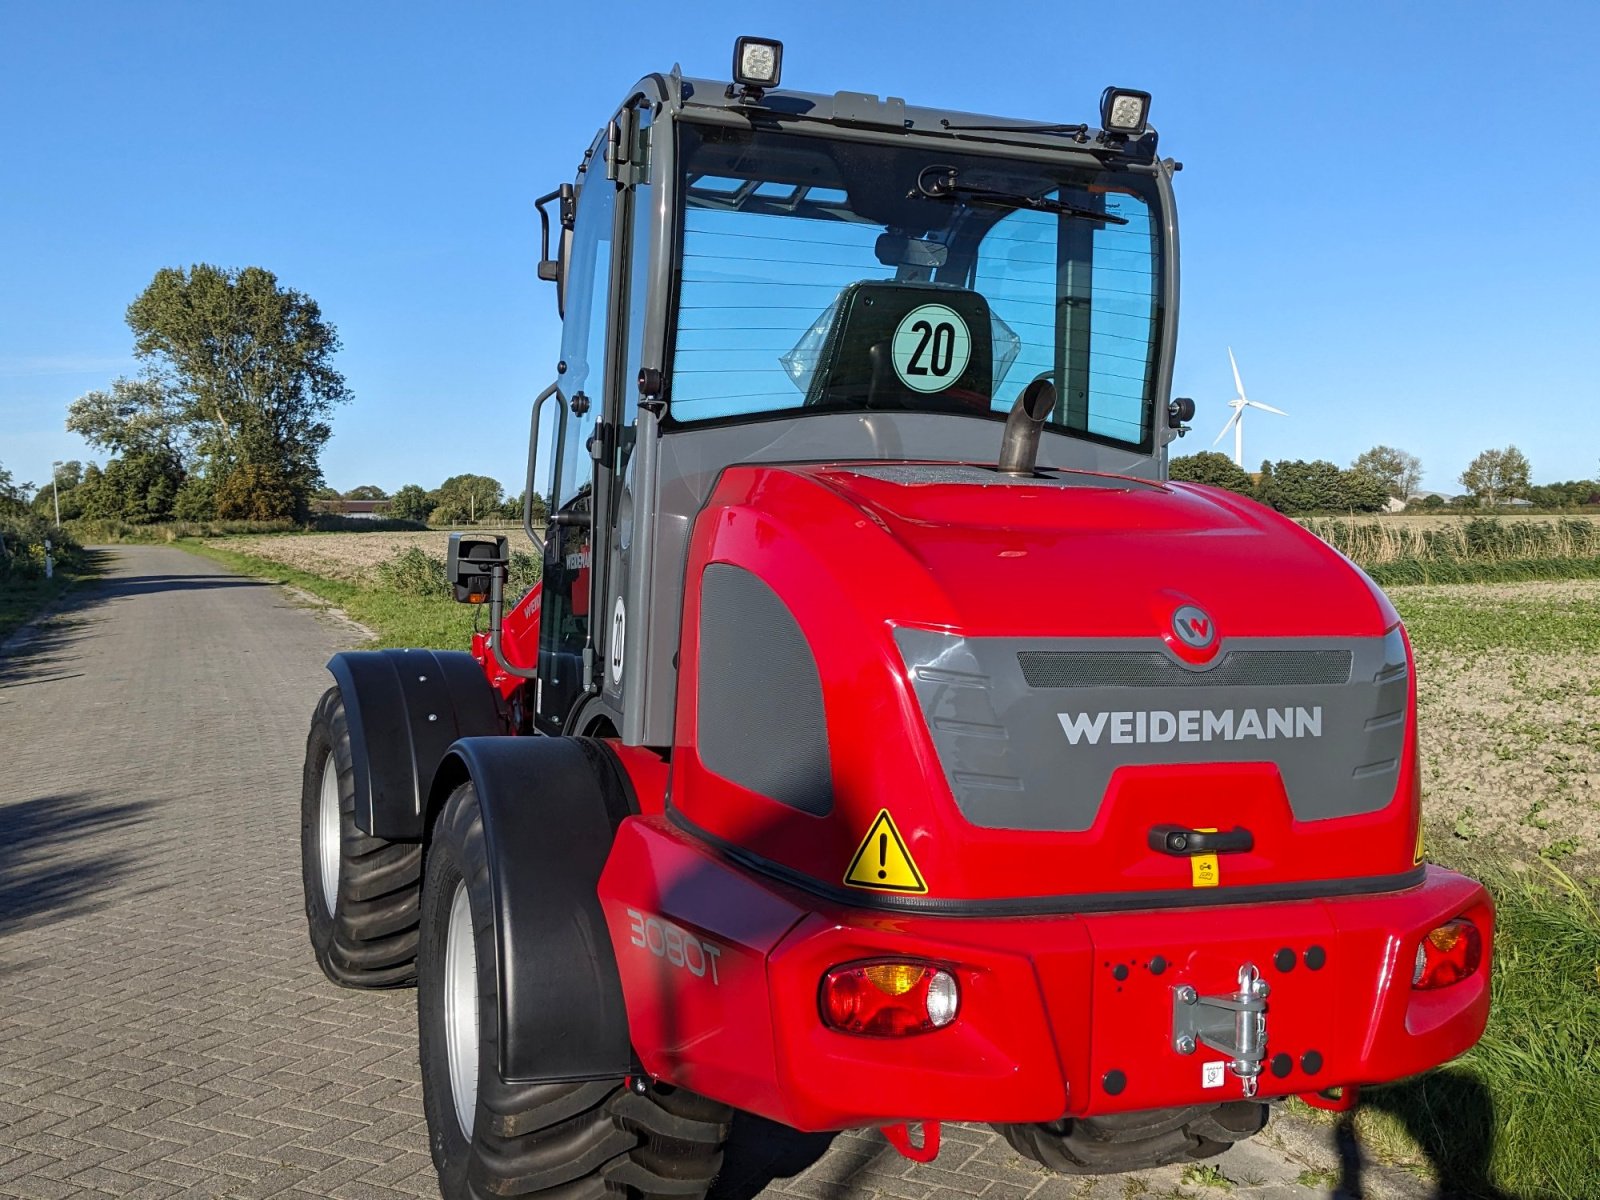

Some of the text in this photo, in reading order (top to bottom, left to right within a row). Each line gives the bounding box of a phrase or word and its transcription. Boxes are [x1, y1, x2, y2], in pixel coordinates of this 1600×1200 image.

[906, 319, 956, 377] 20
[613, 612, 623, 668] 20
[1176, 618, 1209, 639] W
[1056, 706, 1322, 745] WEIDEMANN
[626, 907, 721, 986] 3080T
